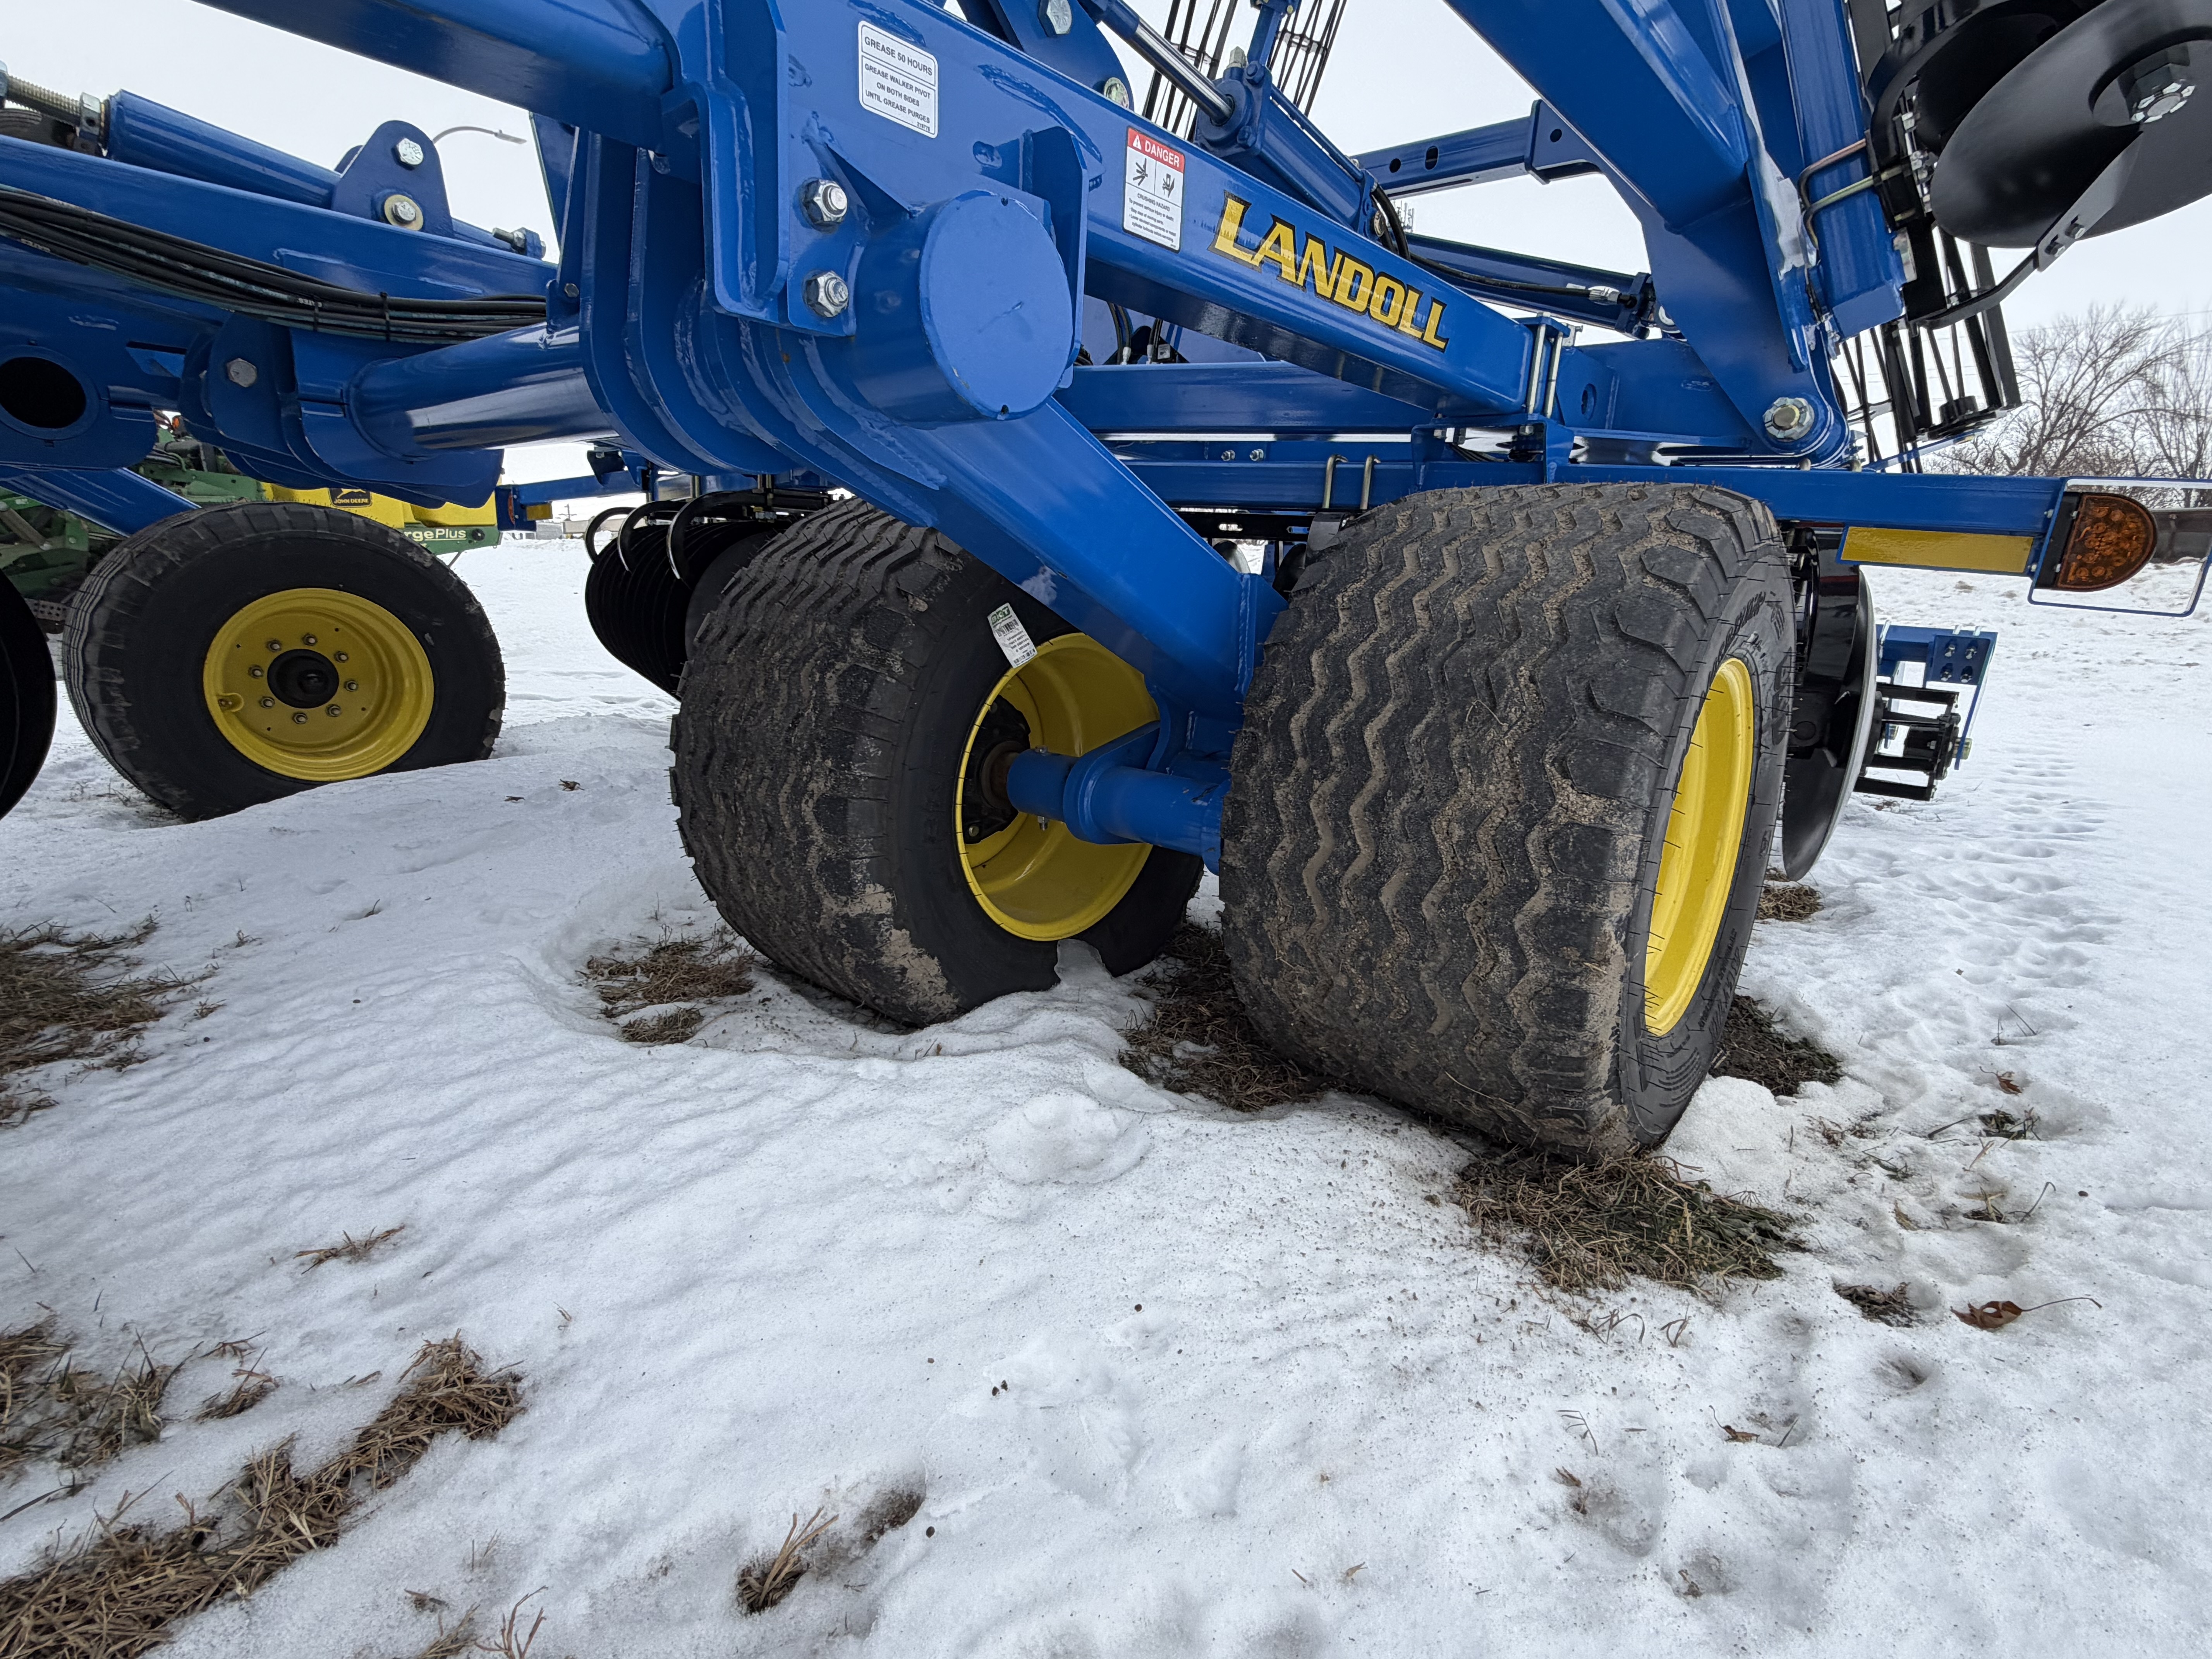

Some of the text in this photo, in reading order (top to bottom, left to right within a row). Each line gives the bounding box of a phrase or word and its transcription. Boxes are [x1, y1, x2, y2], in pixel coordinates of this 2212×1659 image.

[865, 36, 932, 76] GREASE 50 HOURS
[865, 64, 930, 99] GREASE WALKER PIVOT
[877, 82, 919, 106] ON BOTH SIDES
[866, 89, 930, 123] UNTIL GREASE PURGES
[1145, 140, 1179, 168] DANGER
[1207, 191, 1449, 353] LANDOLL
[991, 606, 1011, 625] BKT
